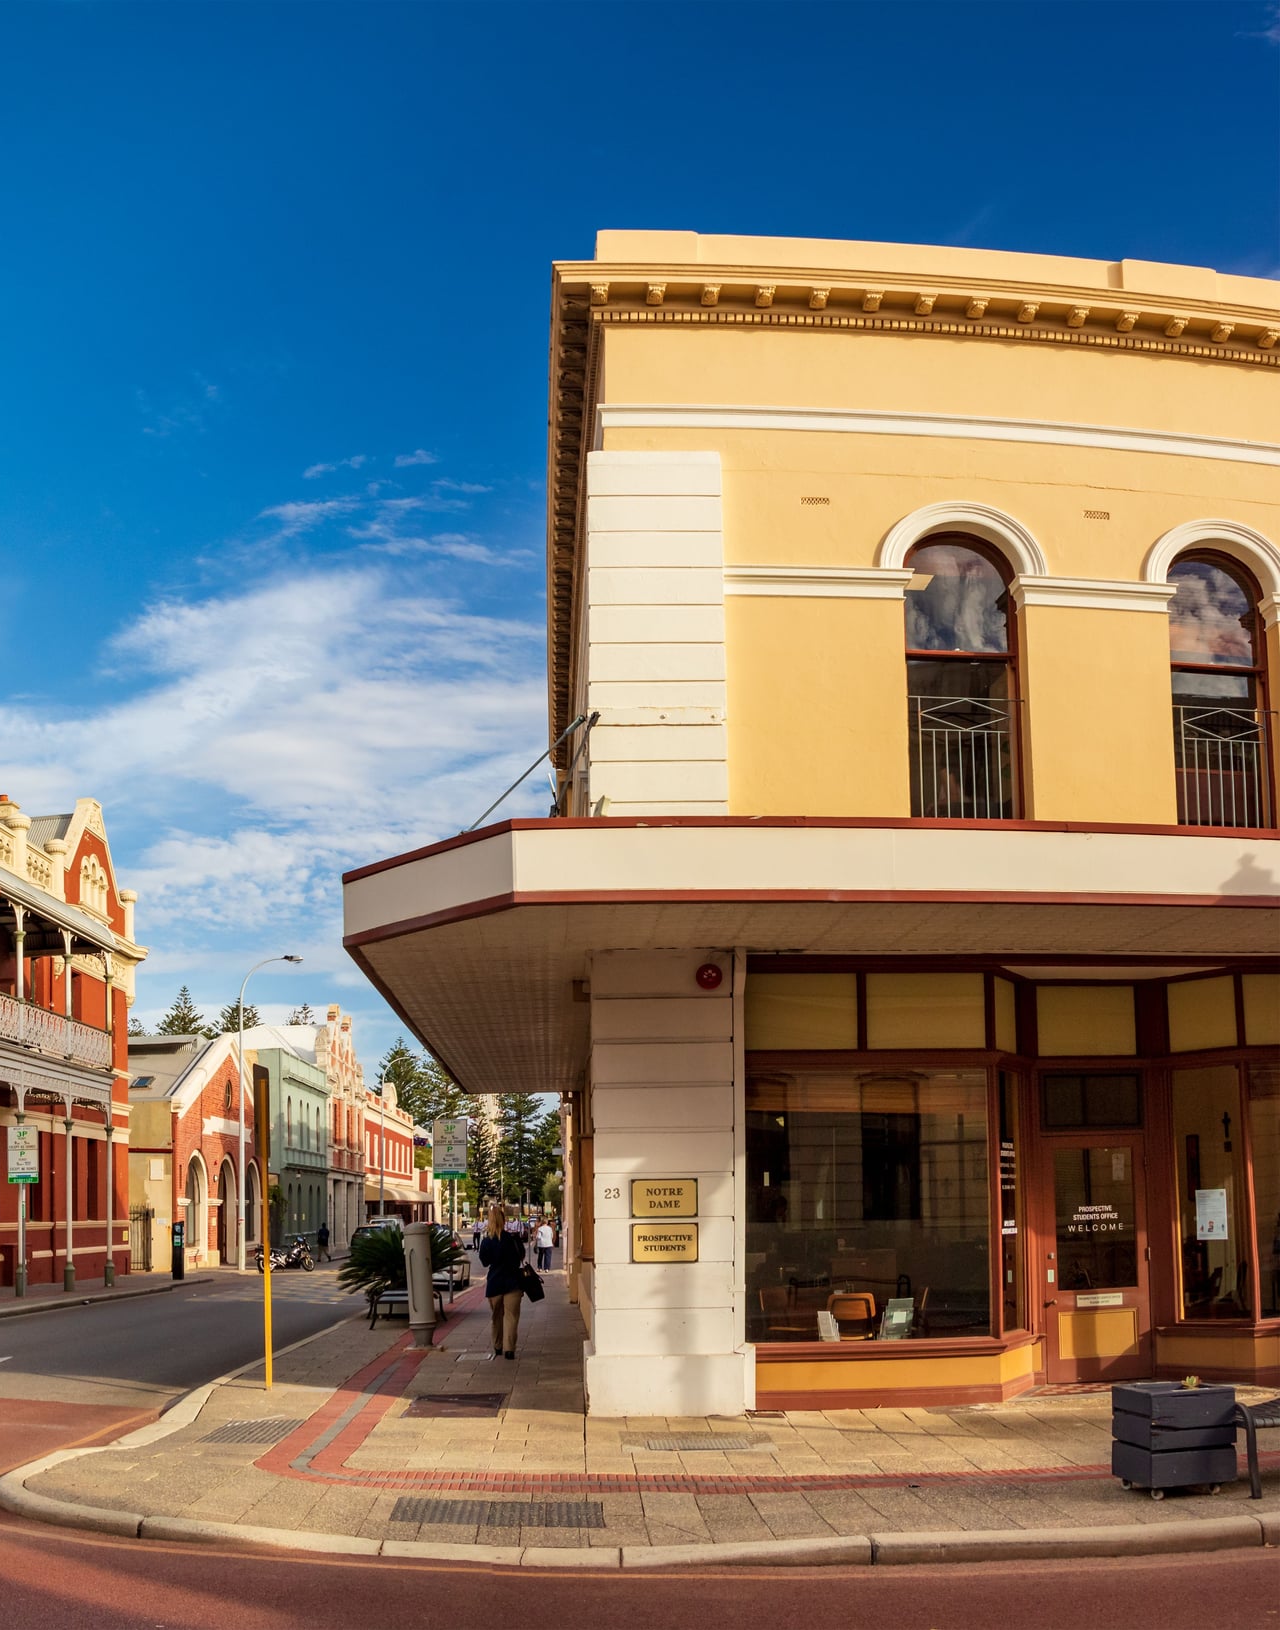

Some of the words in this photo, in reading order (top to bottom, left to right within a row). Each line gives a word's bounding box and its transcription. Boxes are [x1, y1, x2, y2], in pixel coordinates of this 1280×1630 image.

[604, 1188, 621, 1199] 23
[645, 1188, 683, 1197] NOTRE
[649, 1200, 680, 1209] DAME
[1068, 1223, 1124, 1232] WELCOME
[637, 1234, 693, 1242] PROSPECTIVE
